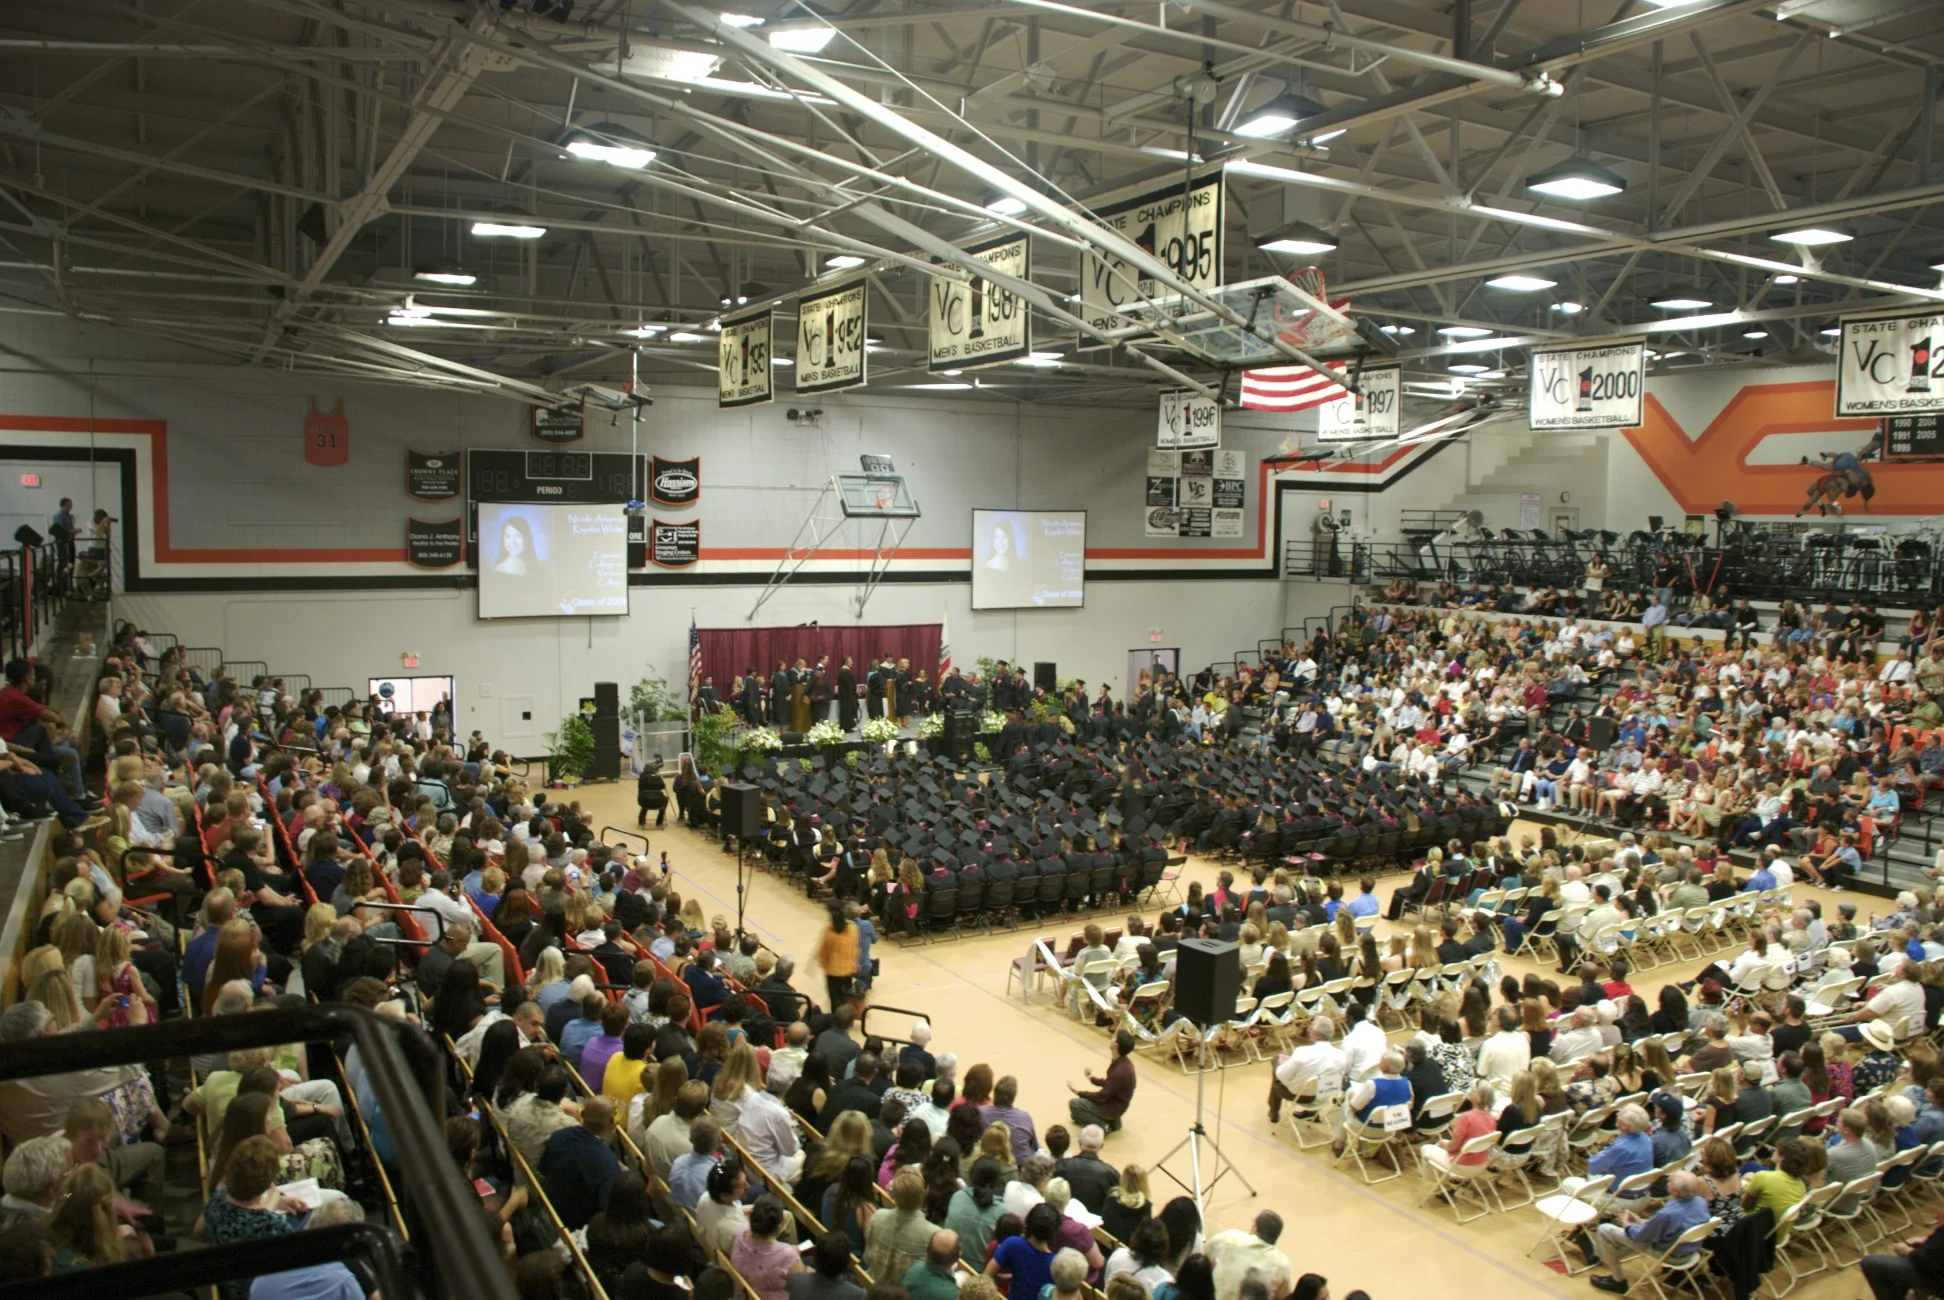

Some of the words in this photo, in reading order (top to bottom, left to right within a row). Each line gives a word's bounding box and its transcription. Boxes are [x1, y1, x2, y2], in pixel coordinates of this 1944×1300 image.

[1095, 216, 1127, 232] TATE
[1137, 191, 1211, 223] CHAMPIONS
[934, 281, 963, 336] VC
[1852, 322, 1897, 334] STATE
[933, 345, 958, 359] MEN'S
[964, 335, 1020, 354] BASKETBALL
[1538, 353, 1570, 363] STATE
[1576, 347, 1637, 360] CHAMPIONS
[1852, 339, 1896, 384] VC
[821, 364, 859, 380] BASKETBALL
[1362, 372, 1393, 380] AMPIONS
[1539, 367, 1569, 405] VC
[1592, 370, 1638, 401] 2000
[1366, 389, 1395, 414] 1997
[1193, 406, 1216, 428] 1996
[1572, 414, 1630, 425] BASKETBALL
[316, 433, 337, 448] 31
[1916, 430, 1937, 440] 2005
[536, 486, 563, 495] PERIOD
[629, 532, 643, 540] ORE
